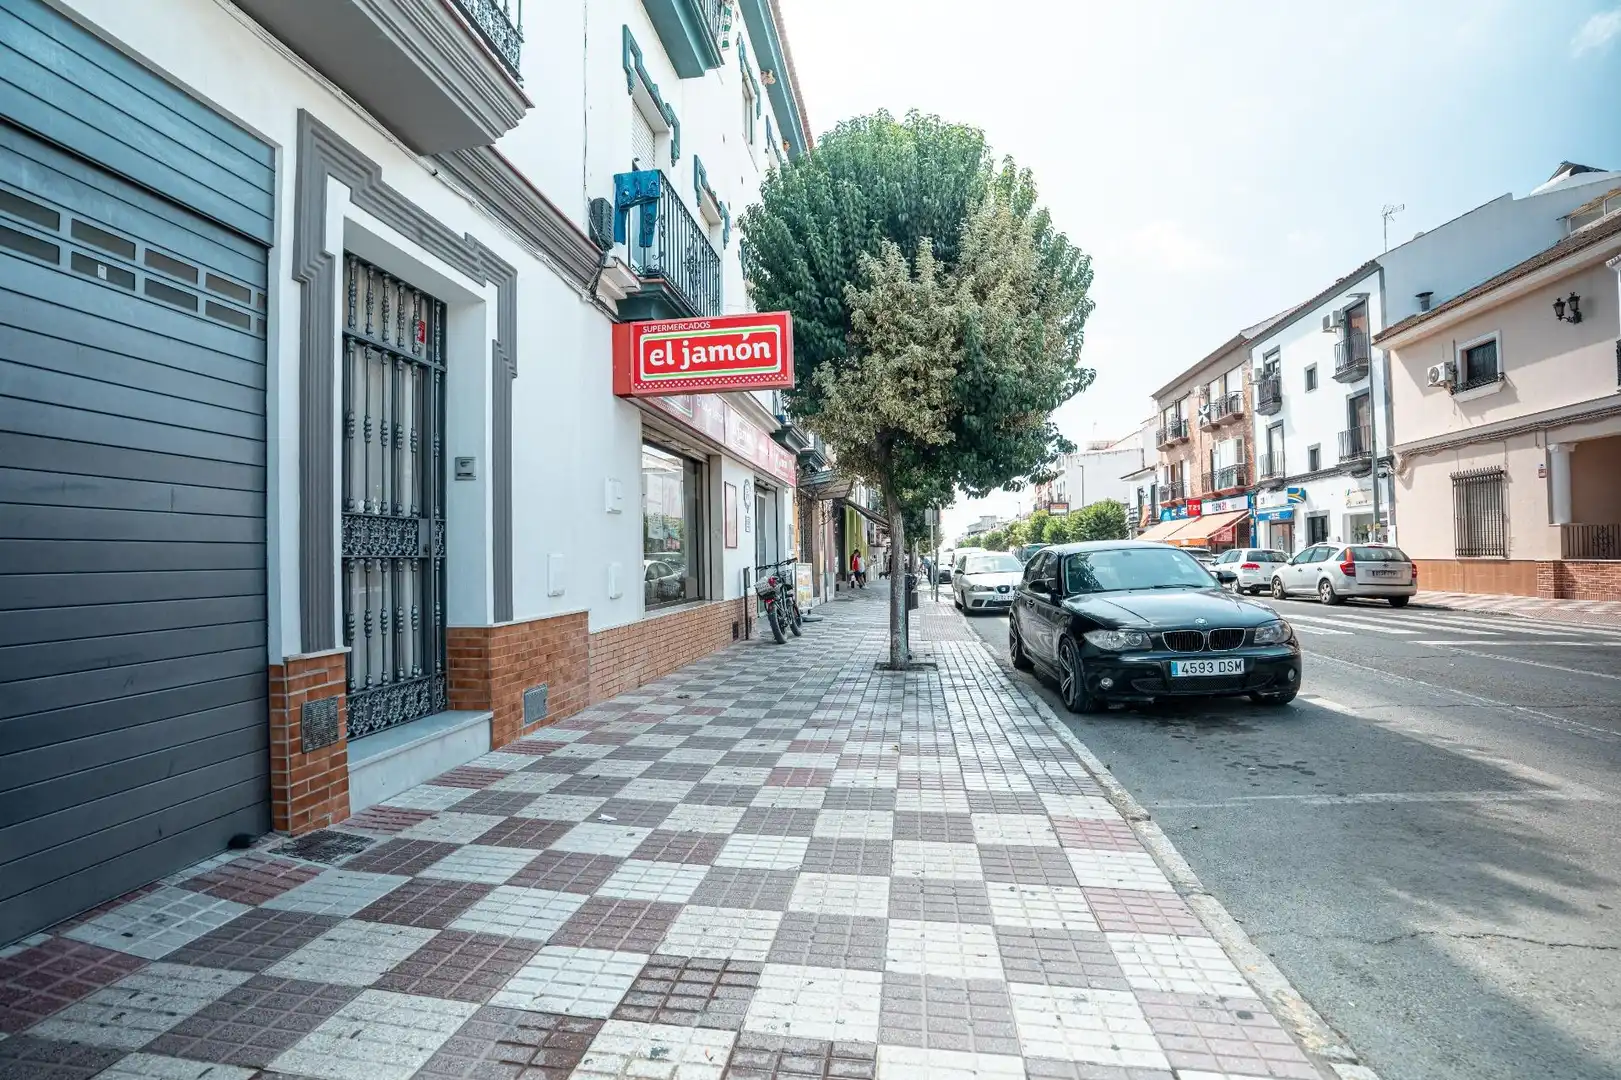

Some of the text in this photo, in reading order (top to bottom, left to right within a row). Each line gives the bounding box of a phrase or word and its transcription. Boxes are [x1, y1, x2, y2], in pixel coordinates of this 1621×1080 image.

[642, 321, 711, 333] SUPERMERCADOS
[649, 333, 772, 370] el jamón
[1181, 660, 1242, 674] 4593 DSM
